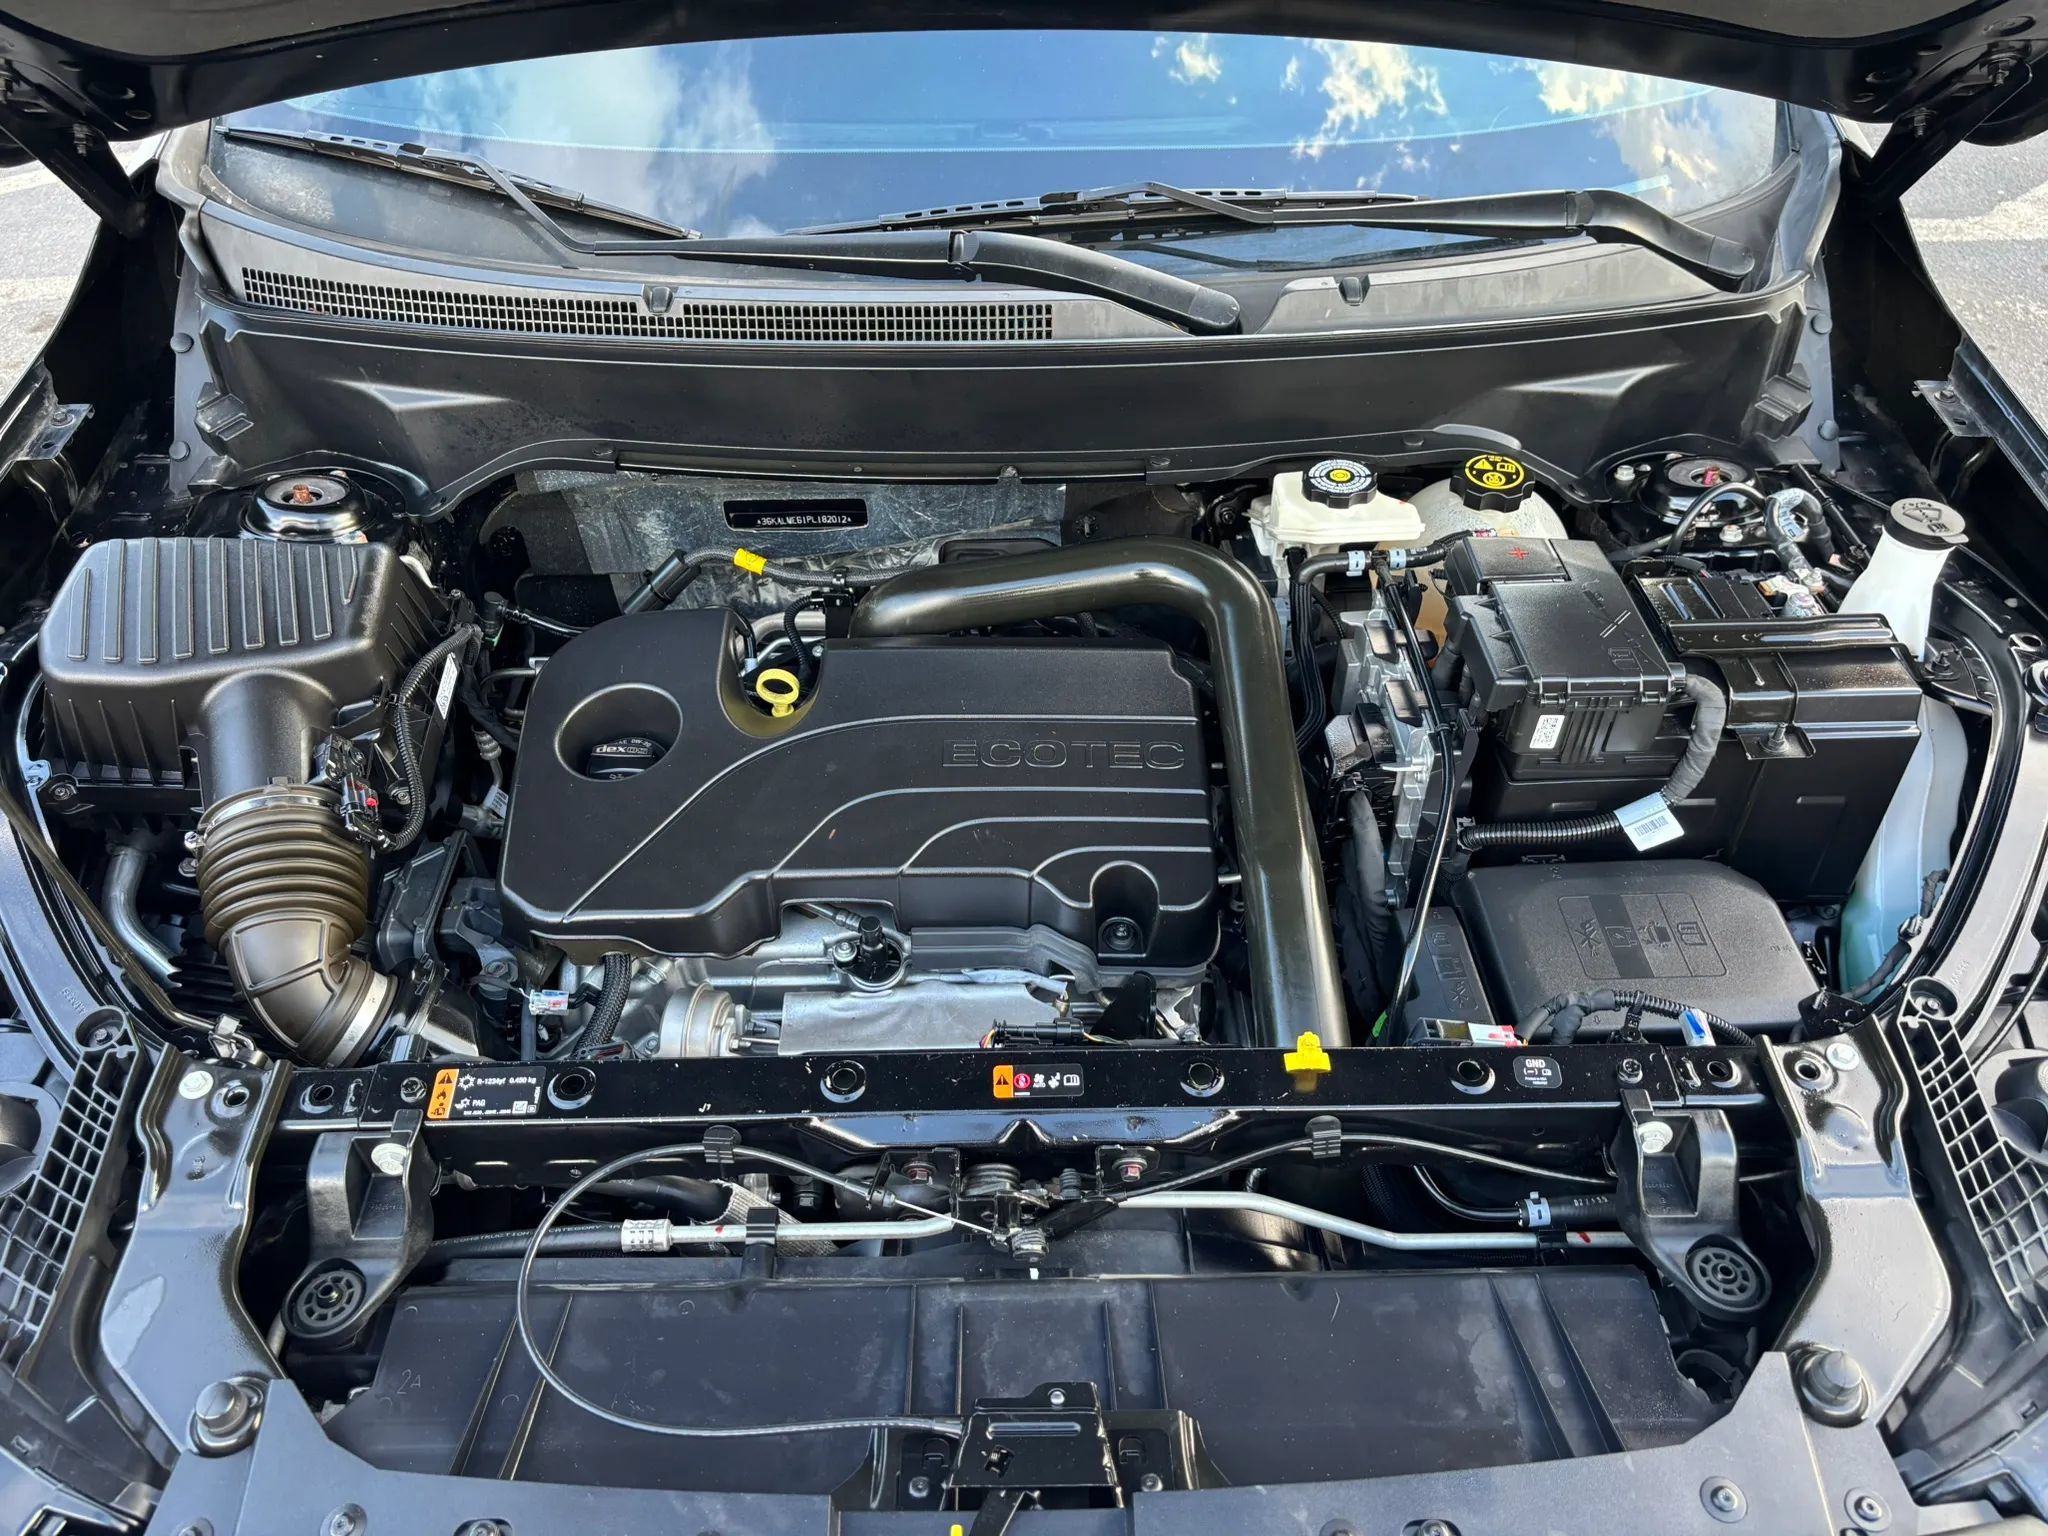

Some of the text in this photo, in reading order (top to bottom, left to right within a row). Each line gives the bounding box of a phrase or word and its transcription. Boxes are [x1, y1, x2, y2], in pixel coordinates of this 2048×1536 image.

[942, 739, 1185, 770] ECOTEC
[1525, 1058, 1546, 1068] GND
[528, 1076, 537, 1084] kg
[472, 1099, 486, 1107] PAG
[453, 1231, 530, 1244] CONSTRUCTION
[548, 1224, 602, 1233] CATEGORY
